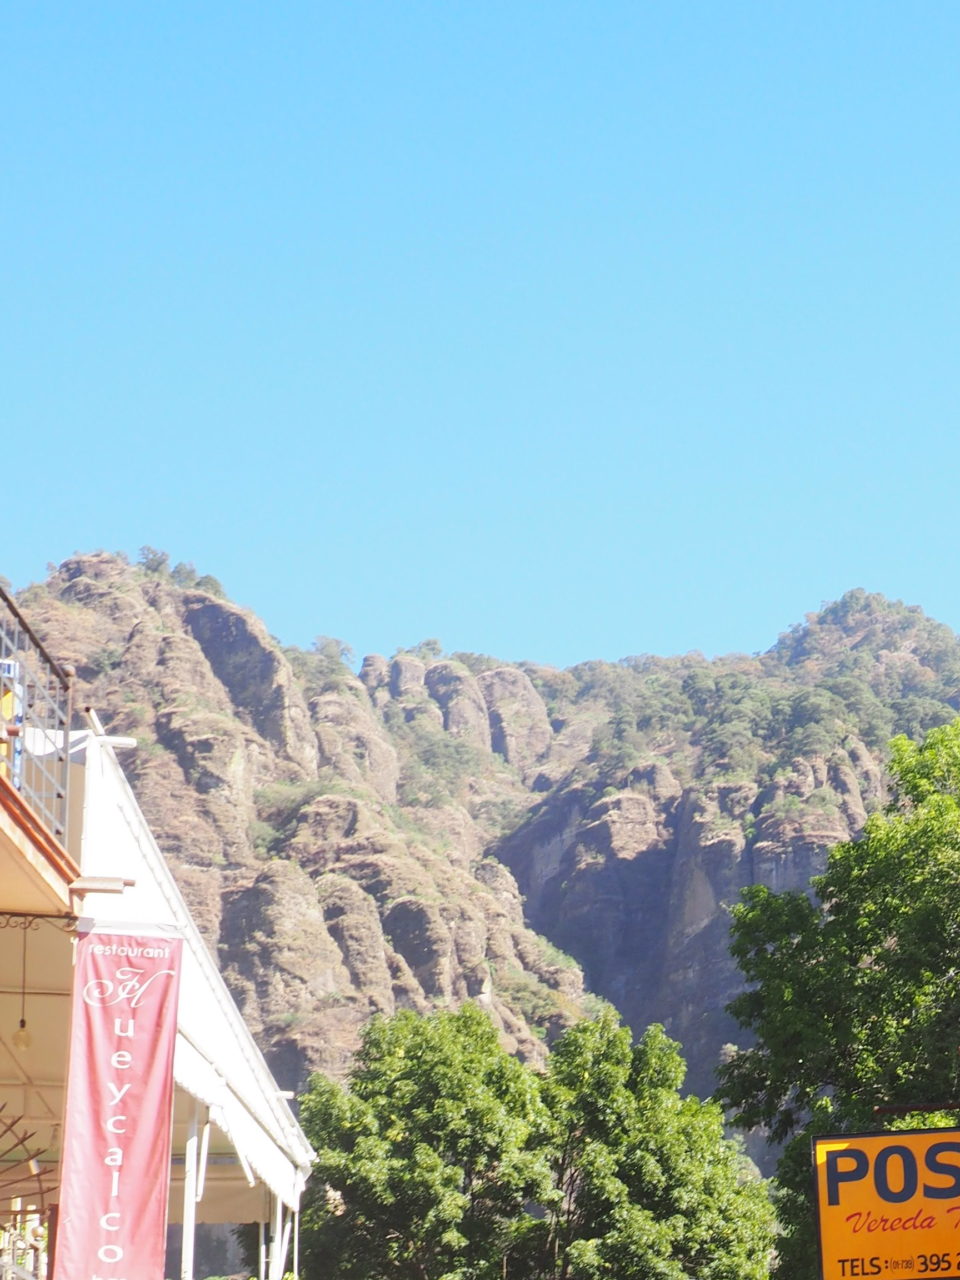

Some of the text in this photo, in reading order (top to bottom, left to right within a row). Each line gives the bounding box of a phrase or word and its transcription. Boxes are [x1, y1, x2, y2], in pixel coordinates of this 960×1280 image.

[88, 943, 170, 959] restaurant
[845, 1209, 936, 1234] Vereda
[917, 1252, 951, 1273] 395
